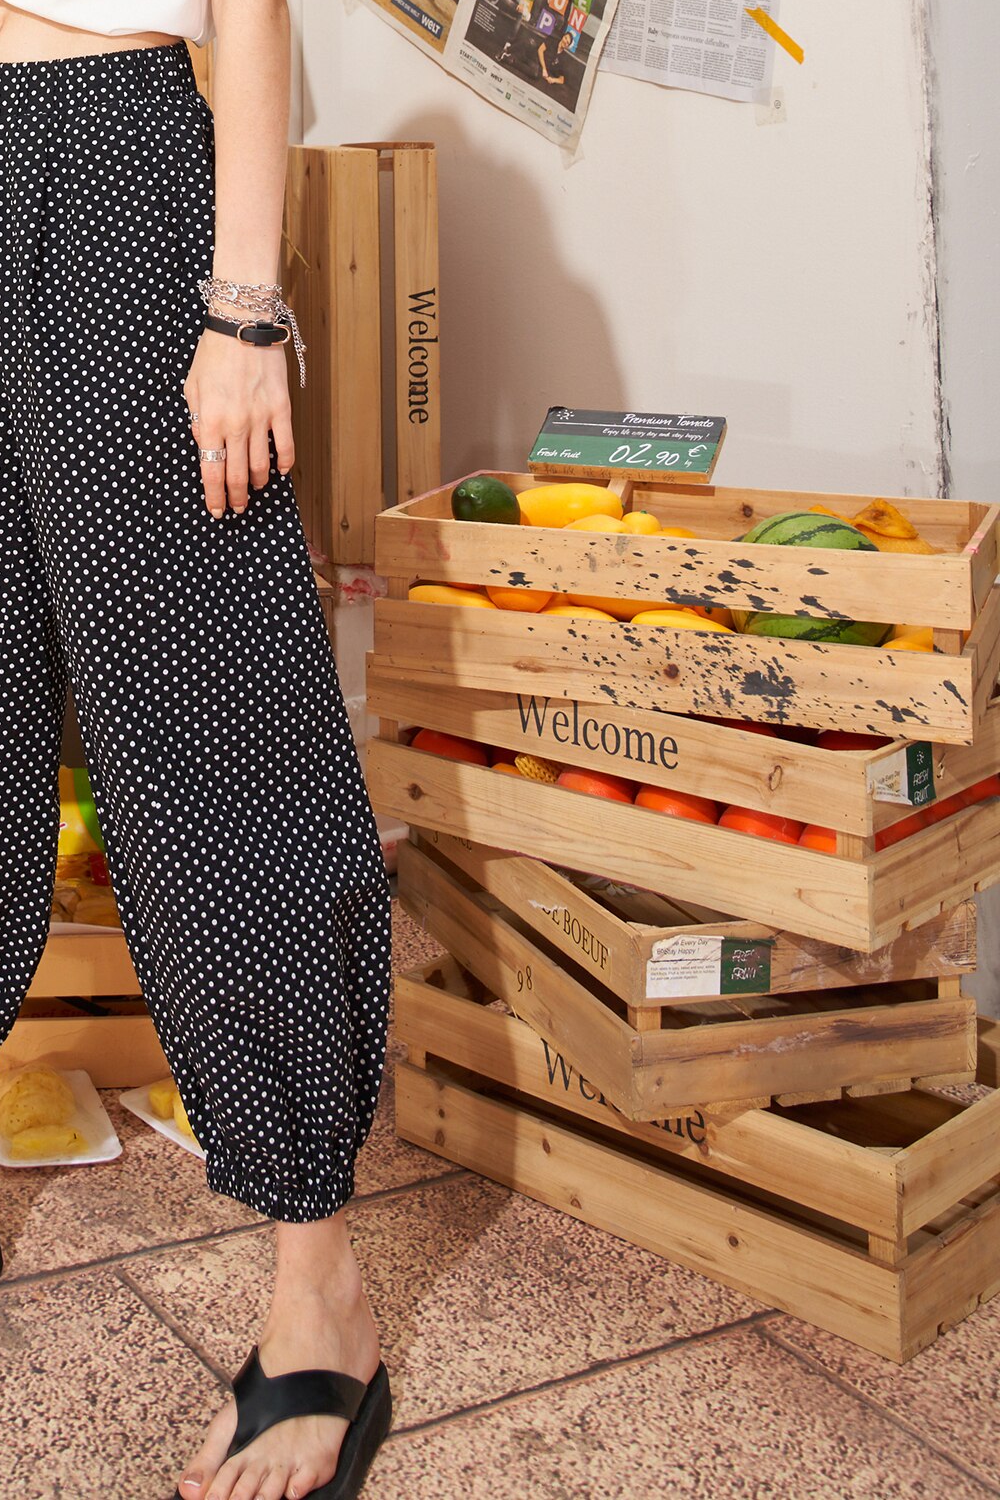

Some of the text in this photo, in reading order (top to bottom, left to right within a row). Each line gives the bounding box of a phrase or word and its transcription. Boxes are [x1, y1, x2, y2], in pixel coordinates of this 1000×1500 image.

[407, 287, 439, 425] Welcome
[622, 413, 714, 428] Premium Tomato
[602, 428, 620, 437] Enjoy
[620, 428, 632, 437] life
[684, 433, 703, 441] happy
[536, 447, 558, 458] Fresh
[559, 449, 582, 459] Fruit
[608, 443, 681, 467] 02,90
[516, 693, 679, 770] Welcome
[563, 908, 610, 971] BOEUF
[680, 939, 697, 947] Every
[698, 939, 709, 947] Day
[678, 948, 696, 956] Happy
